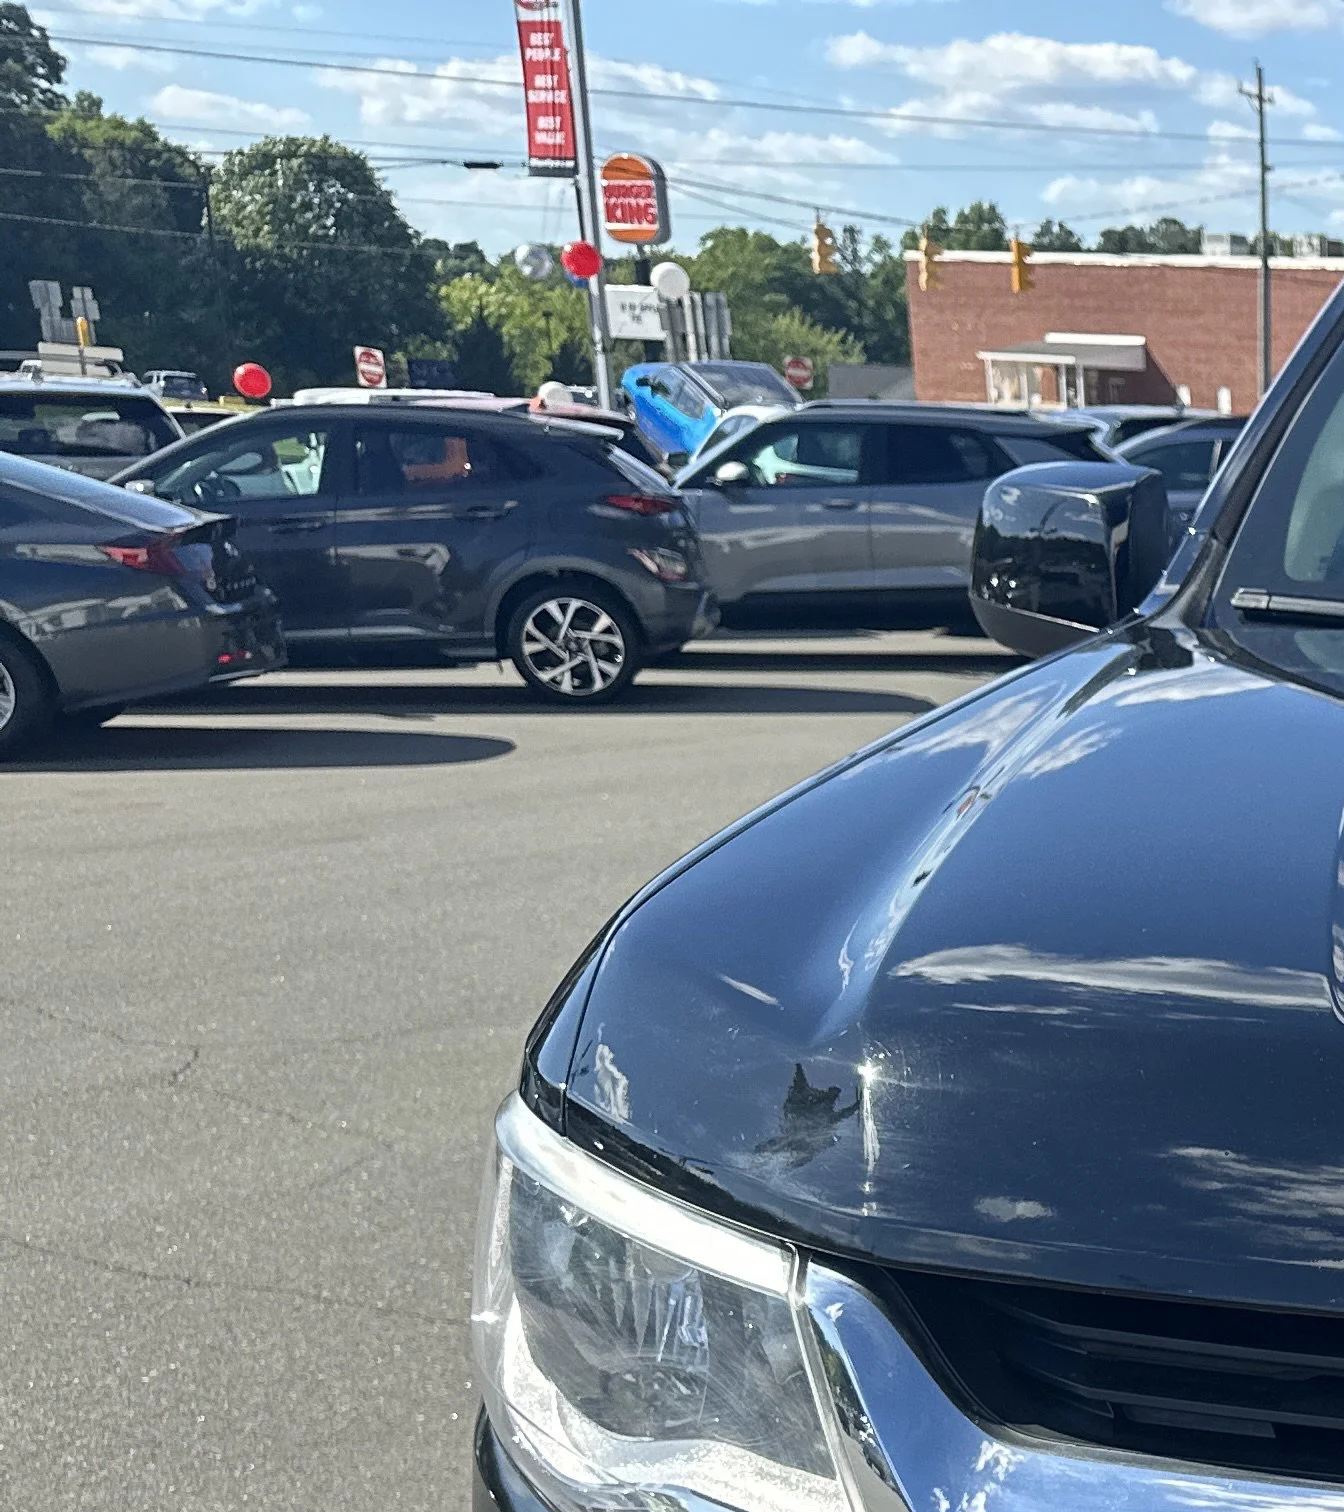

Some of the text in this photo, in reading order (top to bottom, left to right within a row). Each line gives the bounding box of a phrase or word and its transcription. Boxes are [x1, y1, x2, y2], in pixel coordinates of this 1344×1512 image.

[530, 32, 555, 46] BEST
[534, 74, 559, 88] BEST
[606, 200, 658, 225] KING
